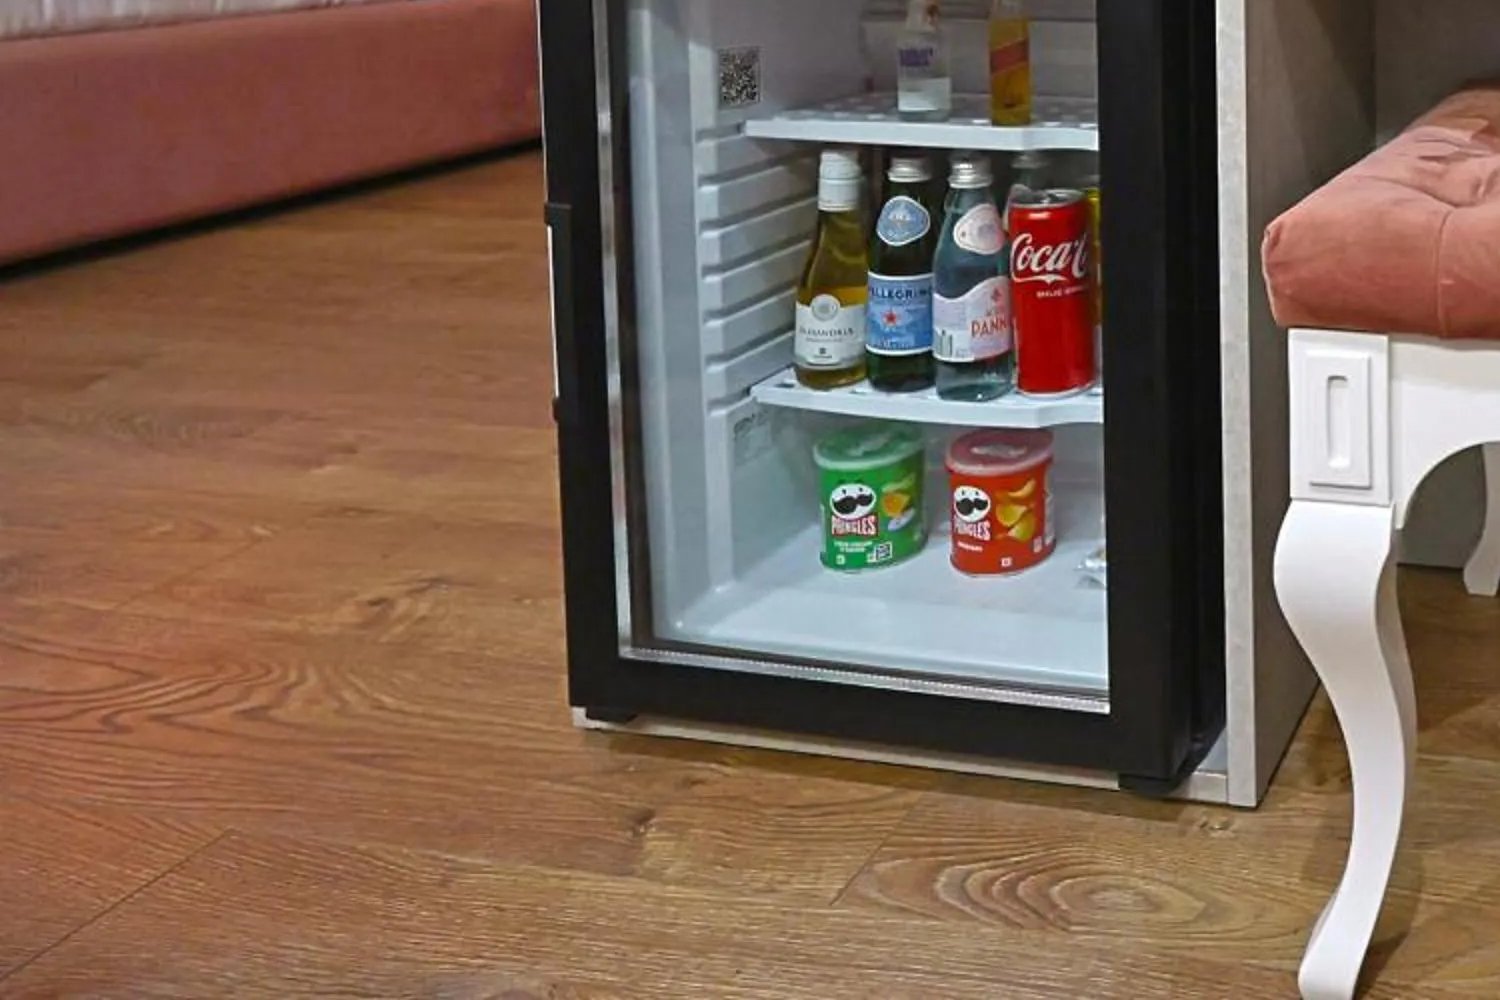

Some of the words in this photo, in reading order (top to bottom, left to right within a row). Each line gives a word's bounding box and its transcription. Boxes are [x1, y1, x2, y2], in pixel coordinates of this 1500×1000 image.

[971, 315, 1008, 338] PANN
[831, 514, 877, 536] PRINGLES
[955, 516, 991, 541] PRINGLES
